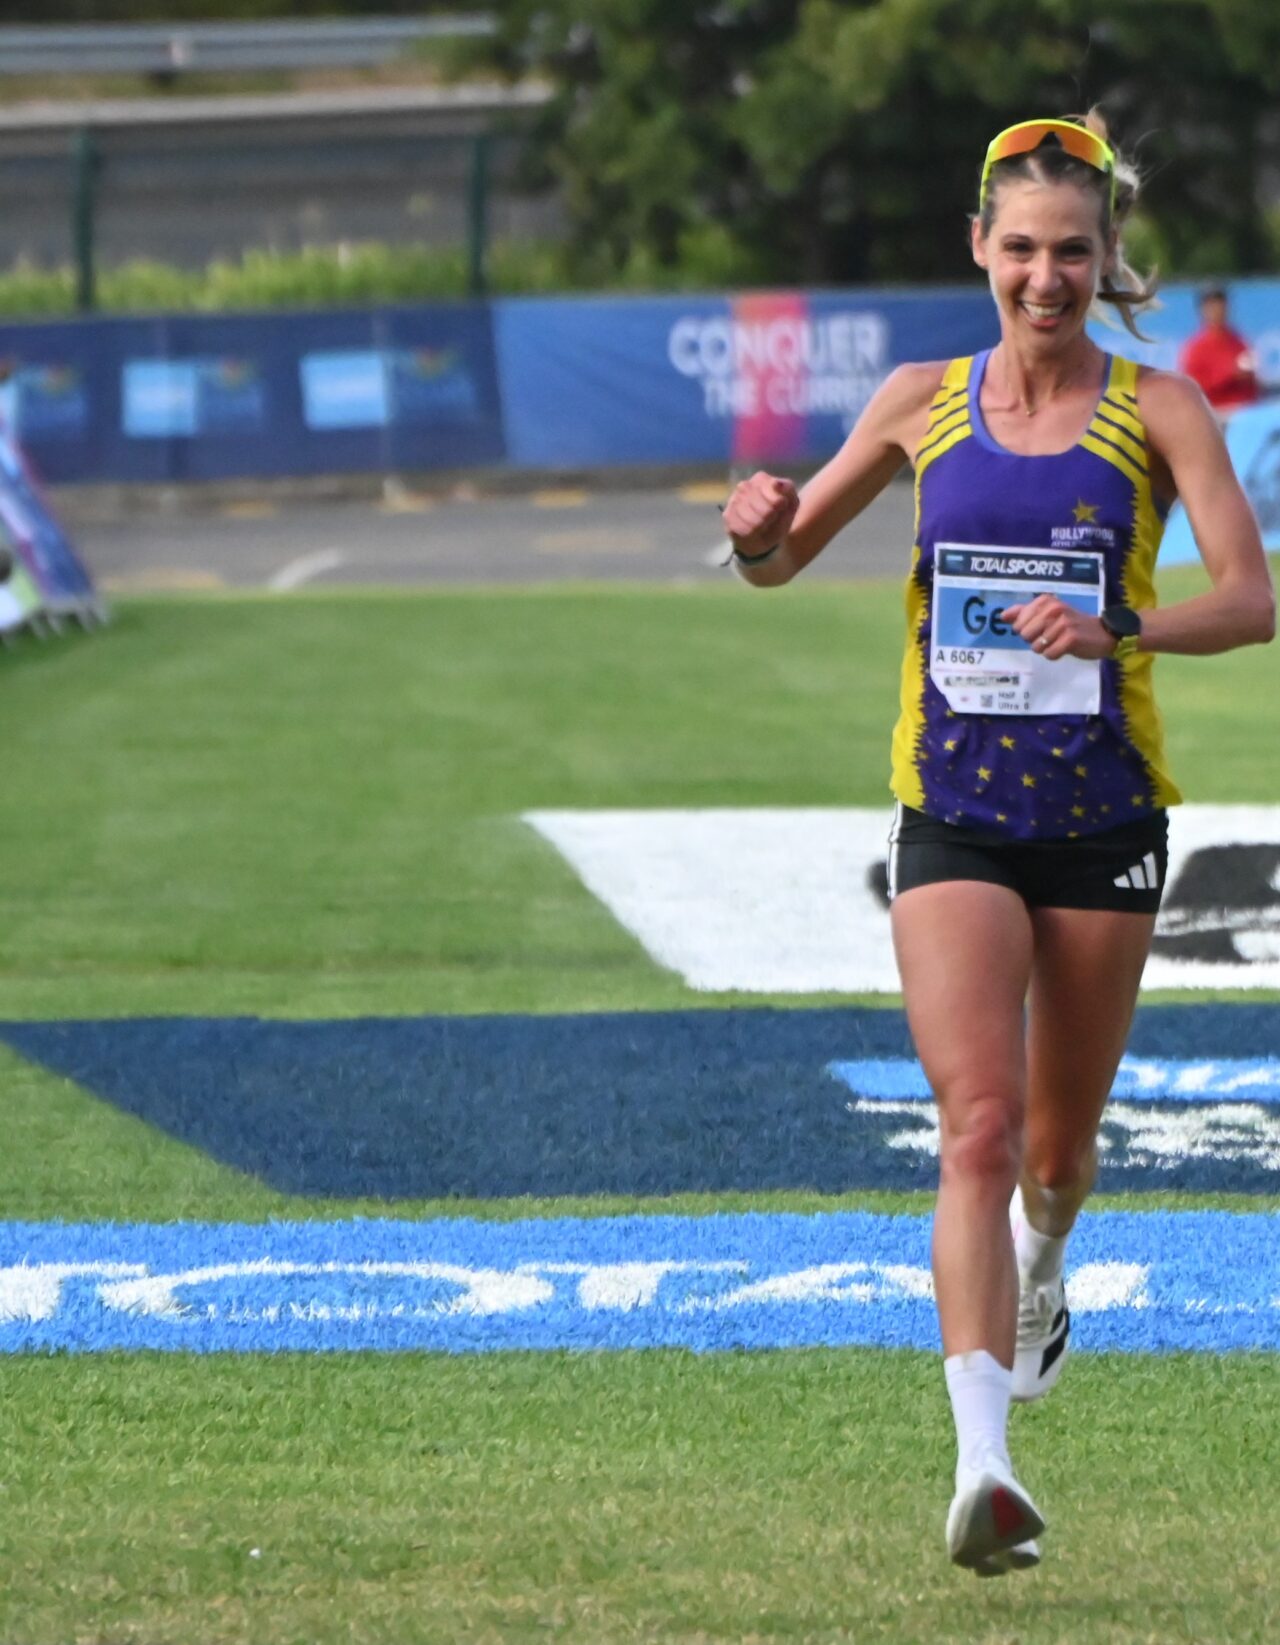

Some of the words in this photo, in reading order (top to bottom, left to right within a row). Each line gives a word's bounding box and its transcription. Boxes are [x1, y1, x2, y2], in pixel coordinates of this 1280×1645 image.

[668, 314, 886, 377] CONQUER
[704, 375, 757, 418] THE
[970, 556, 1065, 577] TOTALSPORTS
[962, 595, 1020, 637] Ge
[936, 651, 945, 662] A
[950, 651, 985, 665] 6067
